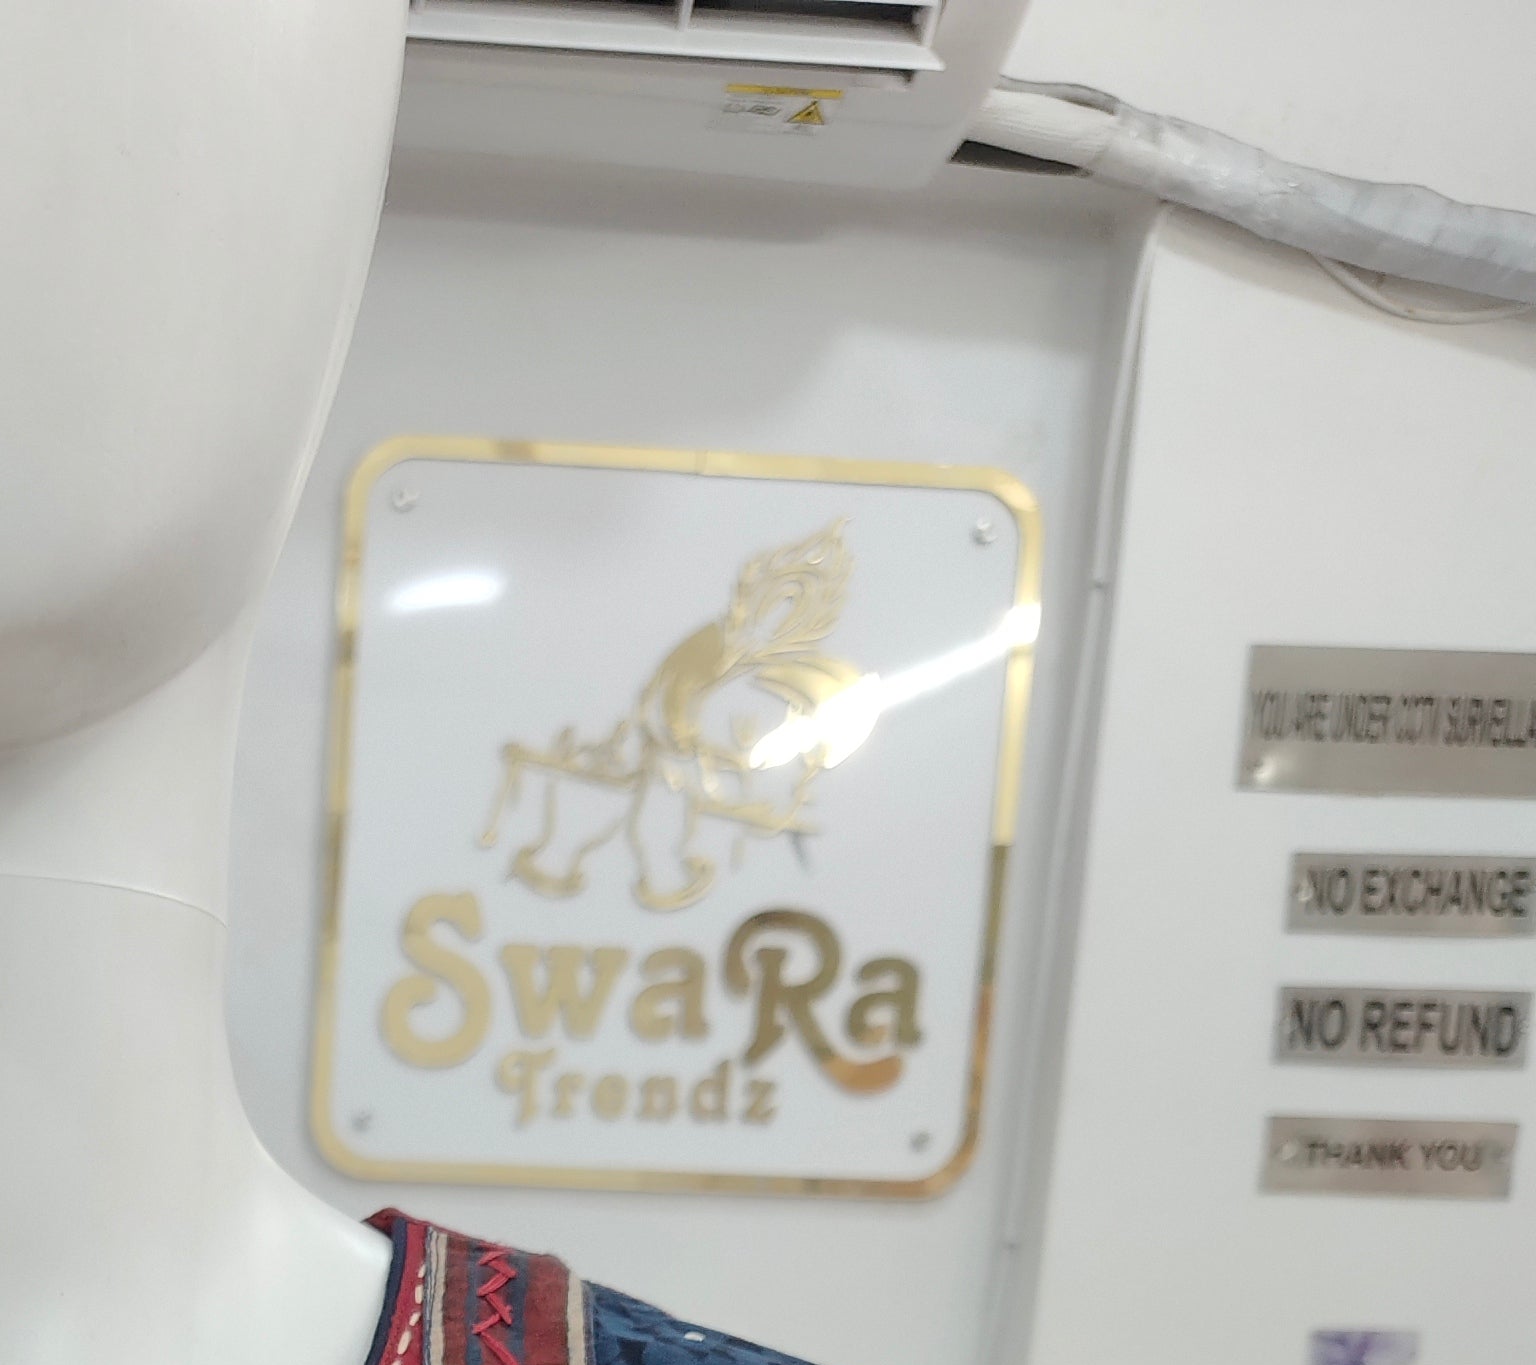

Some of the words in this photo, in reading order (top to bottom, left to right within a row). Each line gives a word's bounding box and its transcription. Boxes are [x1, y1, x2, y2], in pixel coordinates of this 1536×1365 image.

[1305, 866, 1353, 916] NO
[1362, 867, 1531, 918] EXCHANGE
[381, 892, 924, 1096] SwaRa
[1287, 998, 1347, 1050] NO
[1361, 1000, 1517, 1057] REFUND
[496, 1048, 778, 1125] Trendz
[1305, 1140, 1412, 1170] THANK
[1420, 1139, 1484, 1172] YOU
